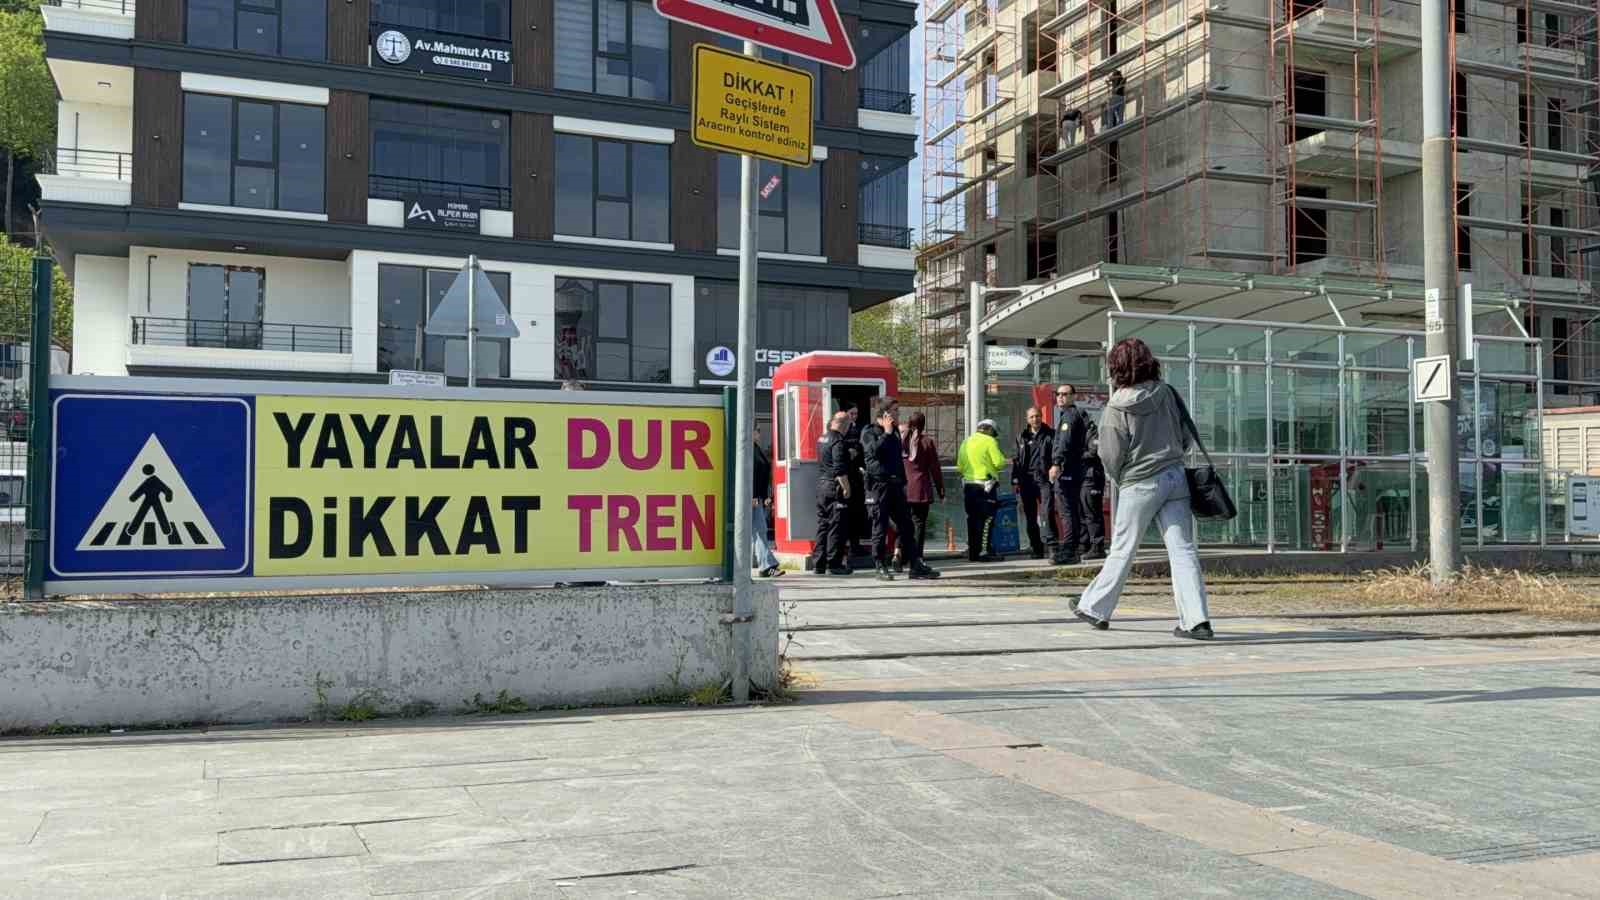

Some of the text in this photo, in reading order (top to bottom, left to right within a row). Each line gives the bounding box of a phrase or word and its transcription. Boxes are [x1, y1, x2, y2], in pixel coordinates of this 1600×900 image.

[415, 39, 511, 63] Av.Mahmut ATEŞ
[723, 71, 785, 100] DİKKAT
[725, 93, 786, 117] Geçişlerde
[698, 117, 806, 150] Aracını kontrol ediniz
[720, 108, 790, 133] Raylı Sistem
[273, 412, 714, 471] YAYALAR DUR
[567, 494, 716, 553] TREN
